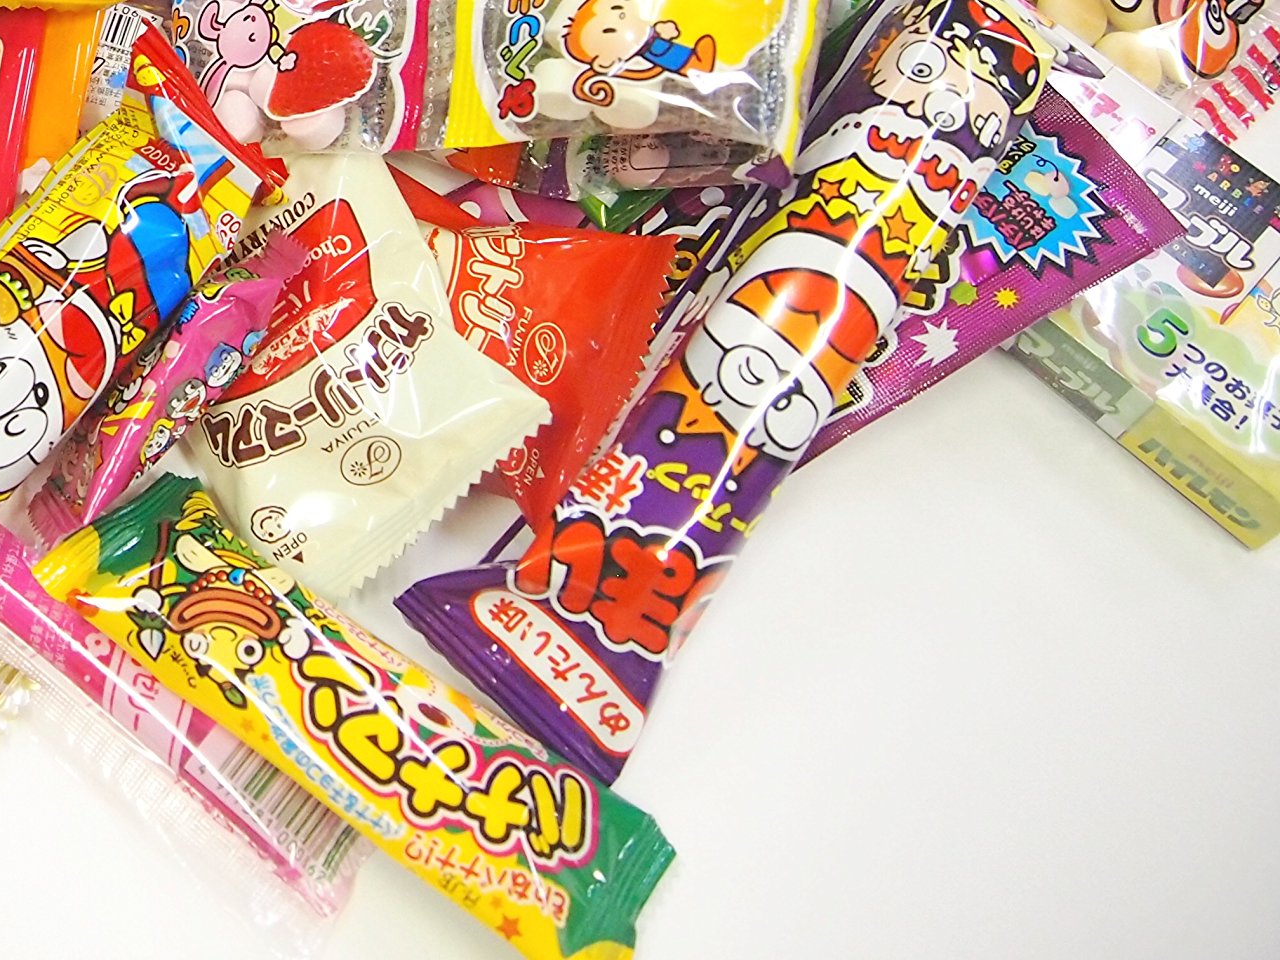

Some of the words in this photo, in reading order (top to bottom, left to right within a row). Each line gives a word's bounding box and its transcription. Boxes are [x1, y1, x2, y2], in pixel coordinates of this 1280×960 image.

[138, 144, 178, 172] FOOD
[1193, 180, 1238, 218] meiji
[505, 305, 534, 368] FUJIYA
[321, 411, 383, 454] FUJIYA
[523, 447, 542, 487] OPEN
[1136, 437, 1263, 532] ハイレモン
[272, 530, 309, 562] OPEN
[488, 596, 631, 736] めんたい味
[300, 651, 589, 856] バナナマン
